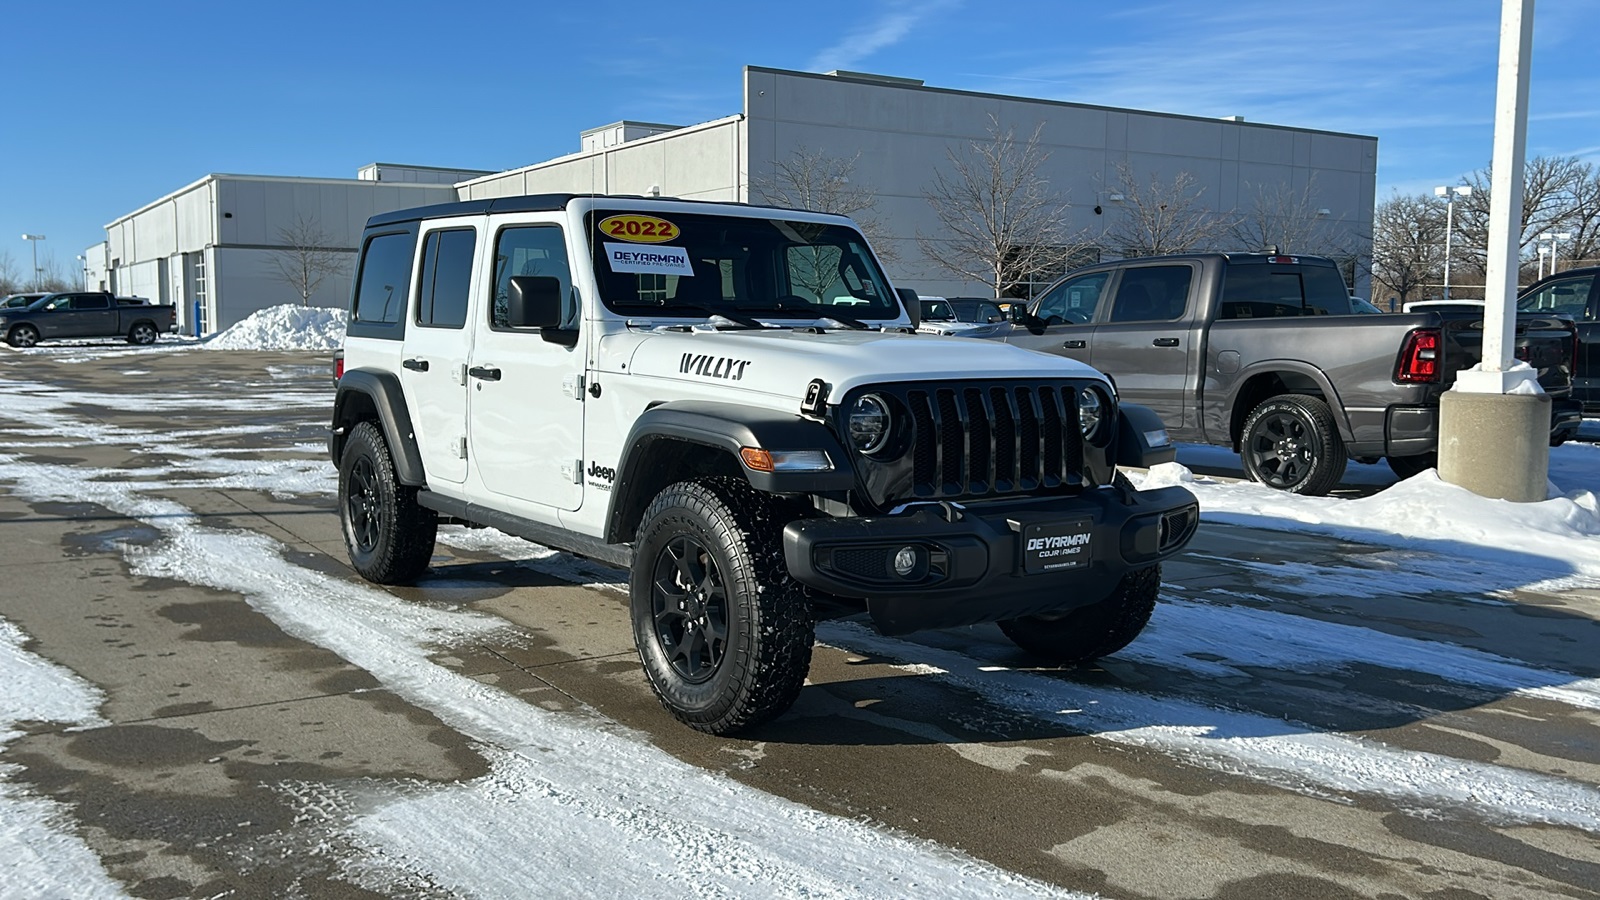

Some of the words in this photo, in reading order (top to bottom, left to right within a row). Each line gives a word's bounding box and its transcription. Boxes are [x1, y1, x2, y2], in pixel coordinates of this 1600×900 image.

[610, 220, 673, 237] 2022
[614, 251, 684, 263] DEYARMAN
[679, 352, 751, 381] WILLYS
[587, 460, 616, 484] Jeep
[1026, 533, 1091, 551] DEYARMAN
[1062, 547, 1081, 556] AMES
